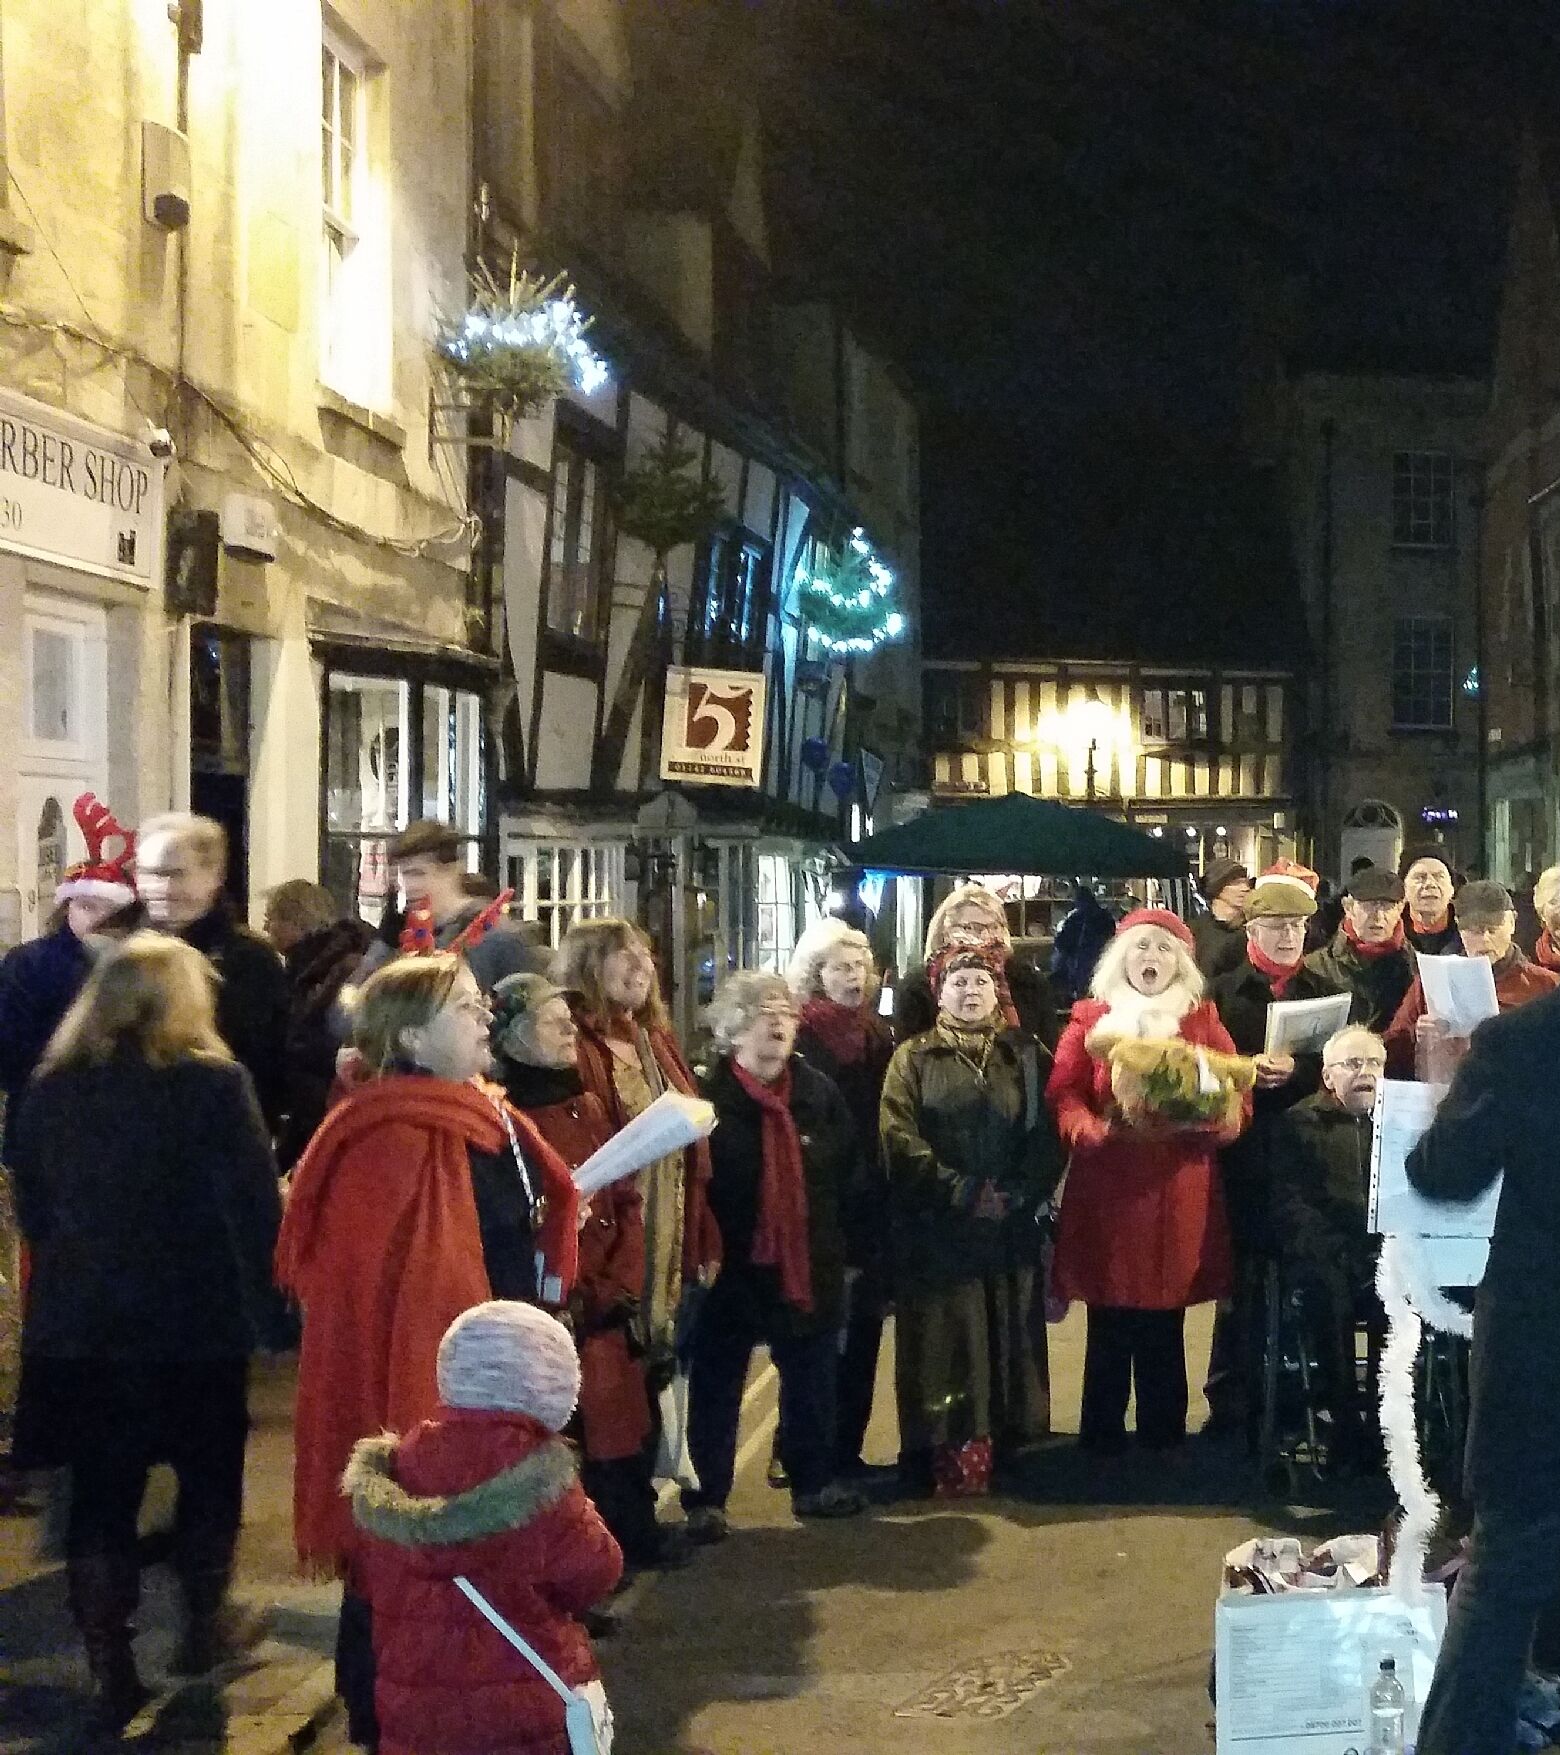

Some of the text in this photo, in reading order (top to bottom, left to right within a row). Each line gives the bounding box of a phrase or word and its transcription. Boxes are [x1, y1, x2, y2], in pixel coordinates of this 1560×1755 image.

[0, 418, 148, 514] RBER SHOP
[691, 680, 753, 751] 5
[700, 751, 732, 763] north
